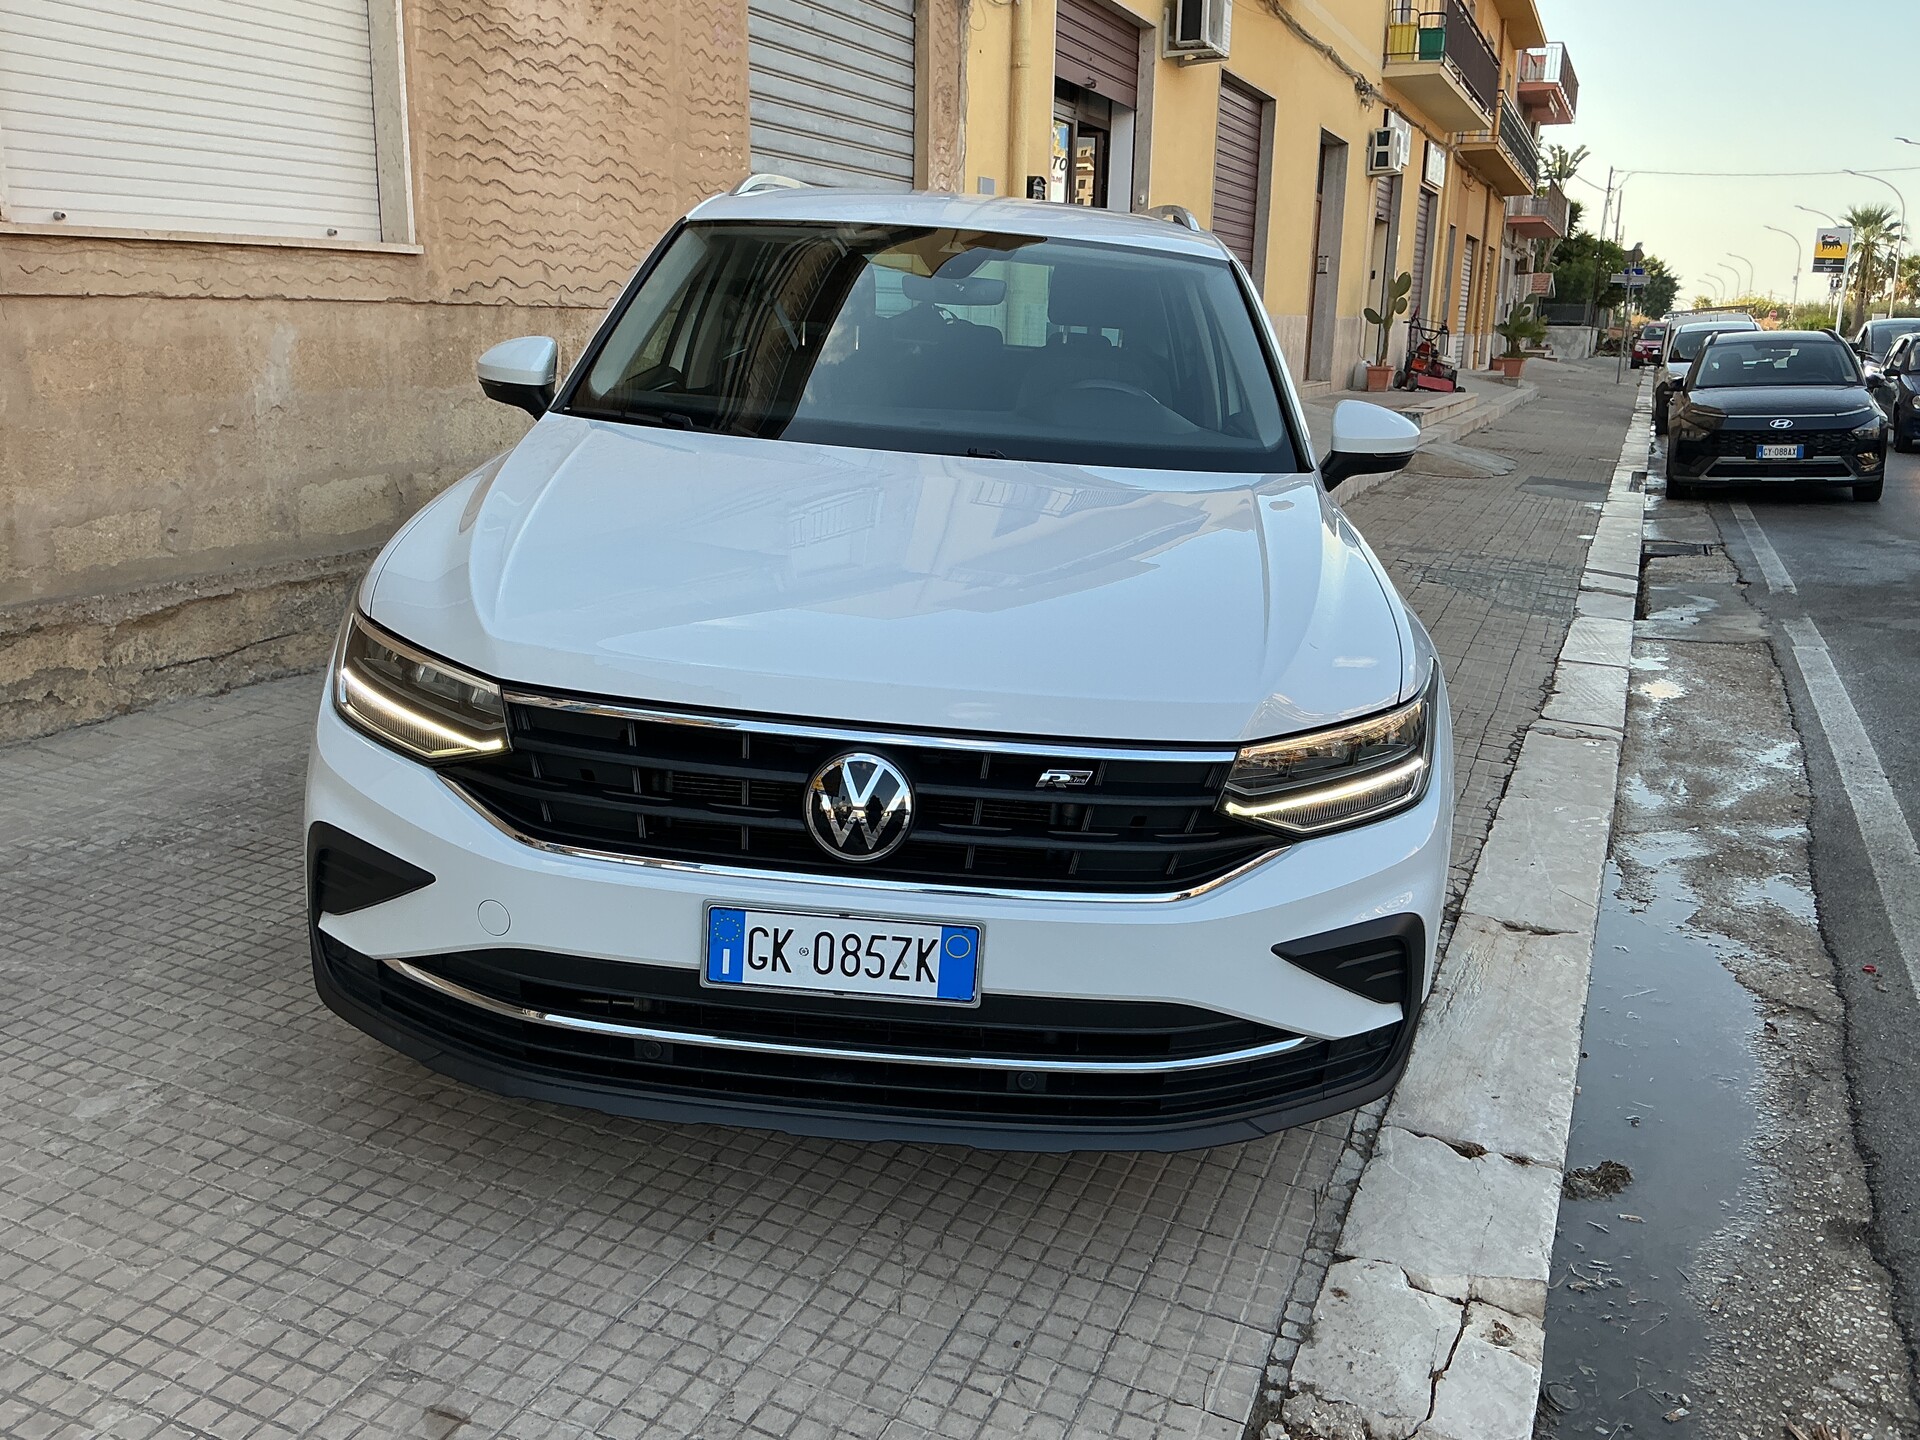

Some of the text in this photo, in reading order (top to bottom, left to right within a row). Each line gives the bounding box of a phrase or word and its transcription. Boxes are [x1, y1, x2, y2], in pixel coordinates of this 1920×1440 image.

[1052, 155, 1068, 171] TO
[747, 926, 939, 984] GK 085ZK
